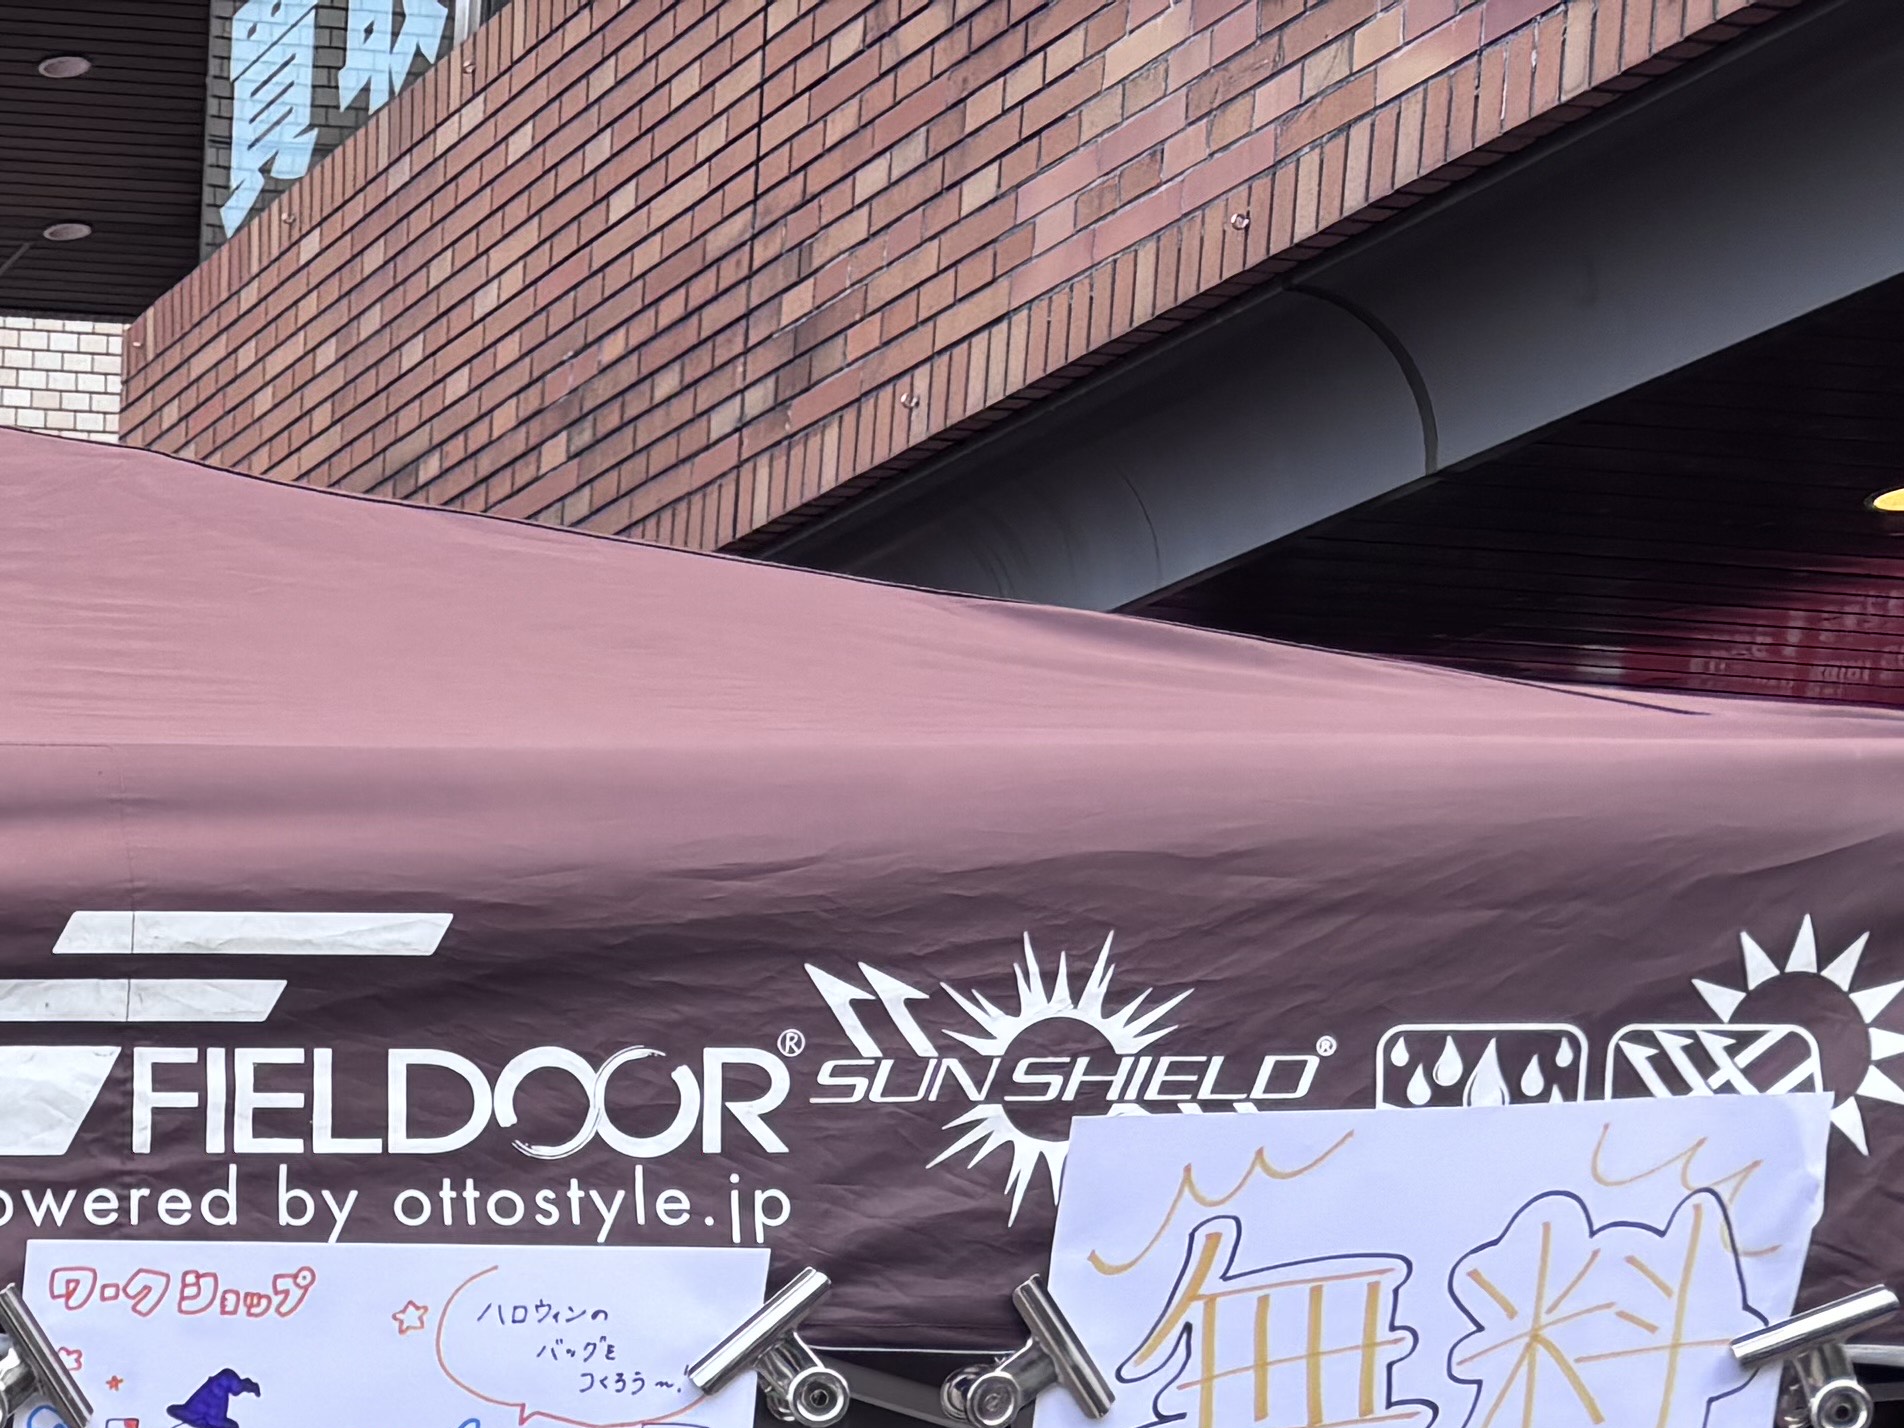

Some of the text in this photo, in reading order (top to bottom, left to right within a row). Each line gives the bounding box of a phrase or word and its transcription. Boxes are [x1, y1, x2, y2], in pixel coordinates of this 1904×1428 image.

[280, 1164, 356, 1242] by
[394, 1164, 792, 1243] ottostyle.jp
[49, 1266, 316, 1317] ワークショップ
[477, 1299, 608, 1325] ハロウィンの
[536, 1335, 618, 1364] バッグを
